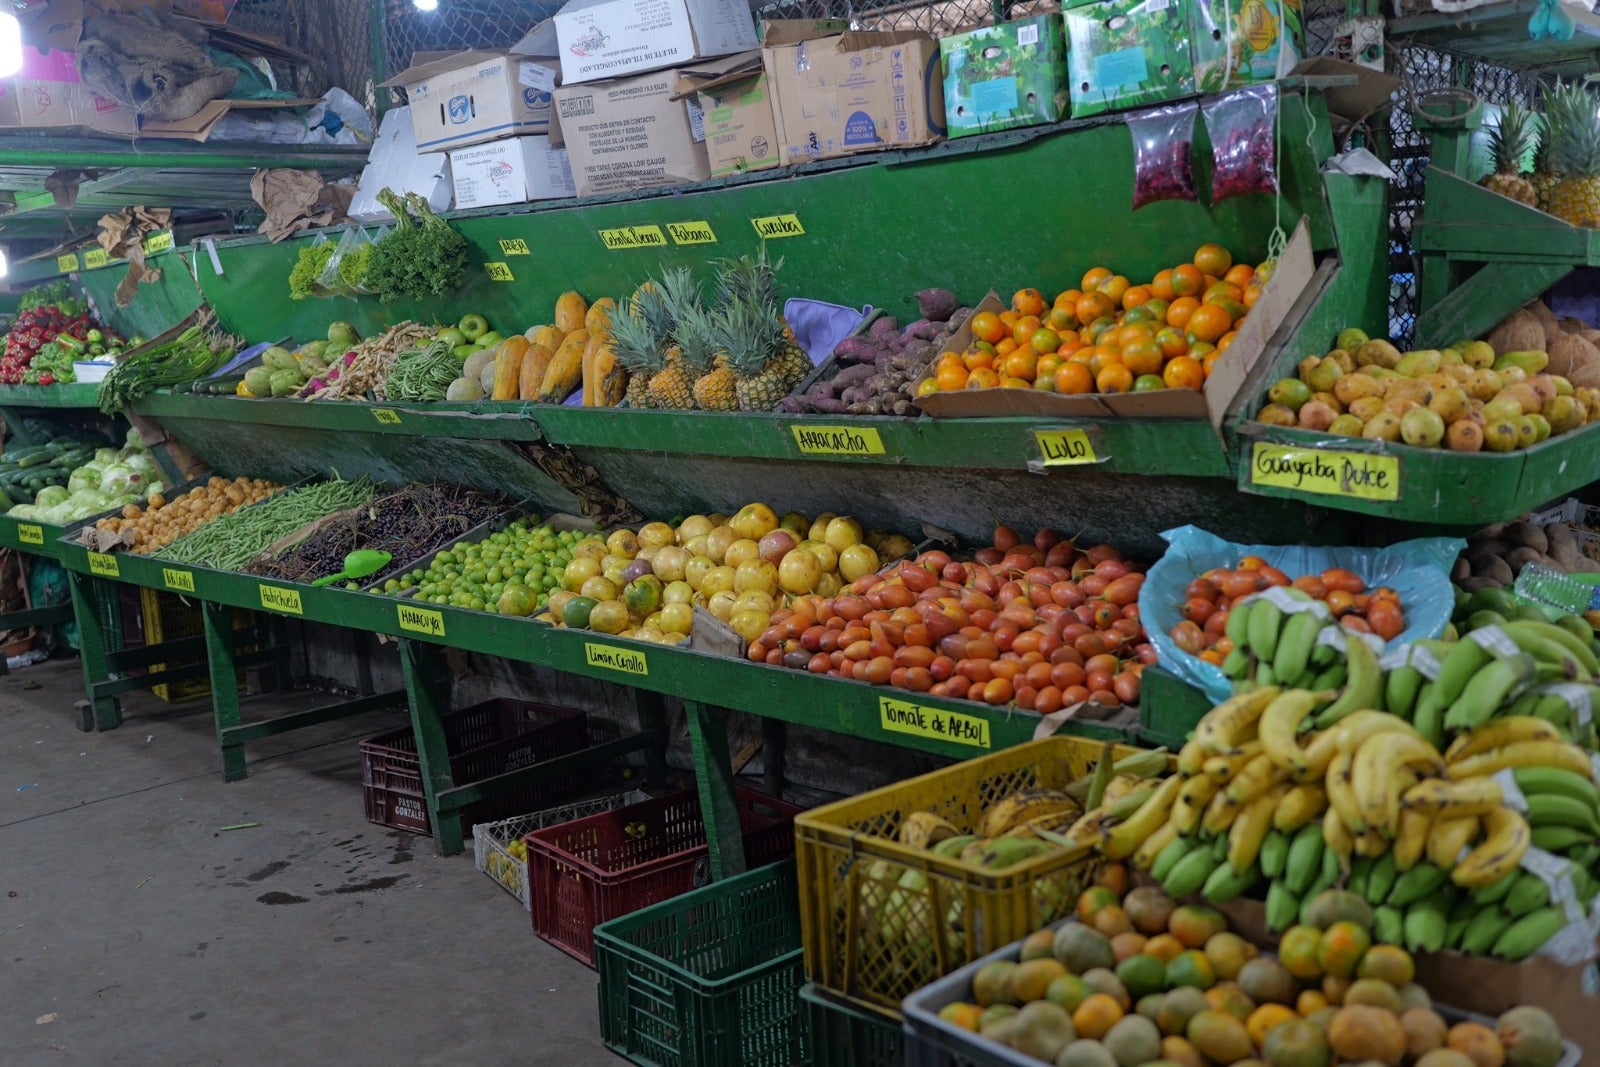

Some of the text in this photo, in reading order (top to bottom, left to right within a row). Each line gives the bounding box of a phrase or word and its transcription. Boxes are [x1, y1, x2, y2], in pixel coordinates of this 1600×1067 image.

[579, 47, 678, 74] FILETE DE TILAPIA CONGELADO
[630, 115, 656, 125] CONTACTO
[1257, 449, 1390, 489] Guayaba Dulce
[262, 588, 301, 611] Habichuela
[394, 805, 425, 822] GONZALEZ
[397, 797, 421, 811] PASTOR
